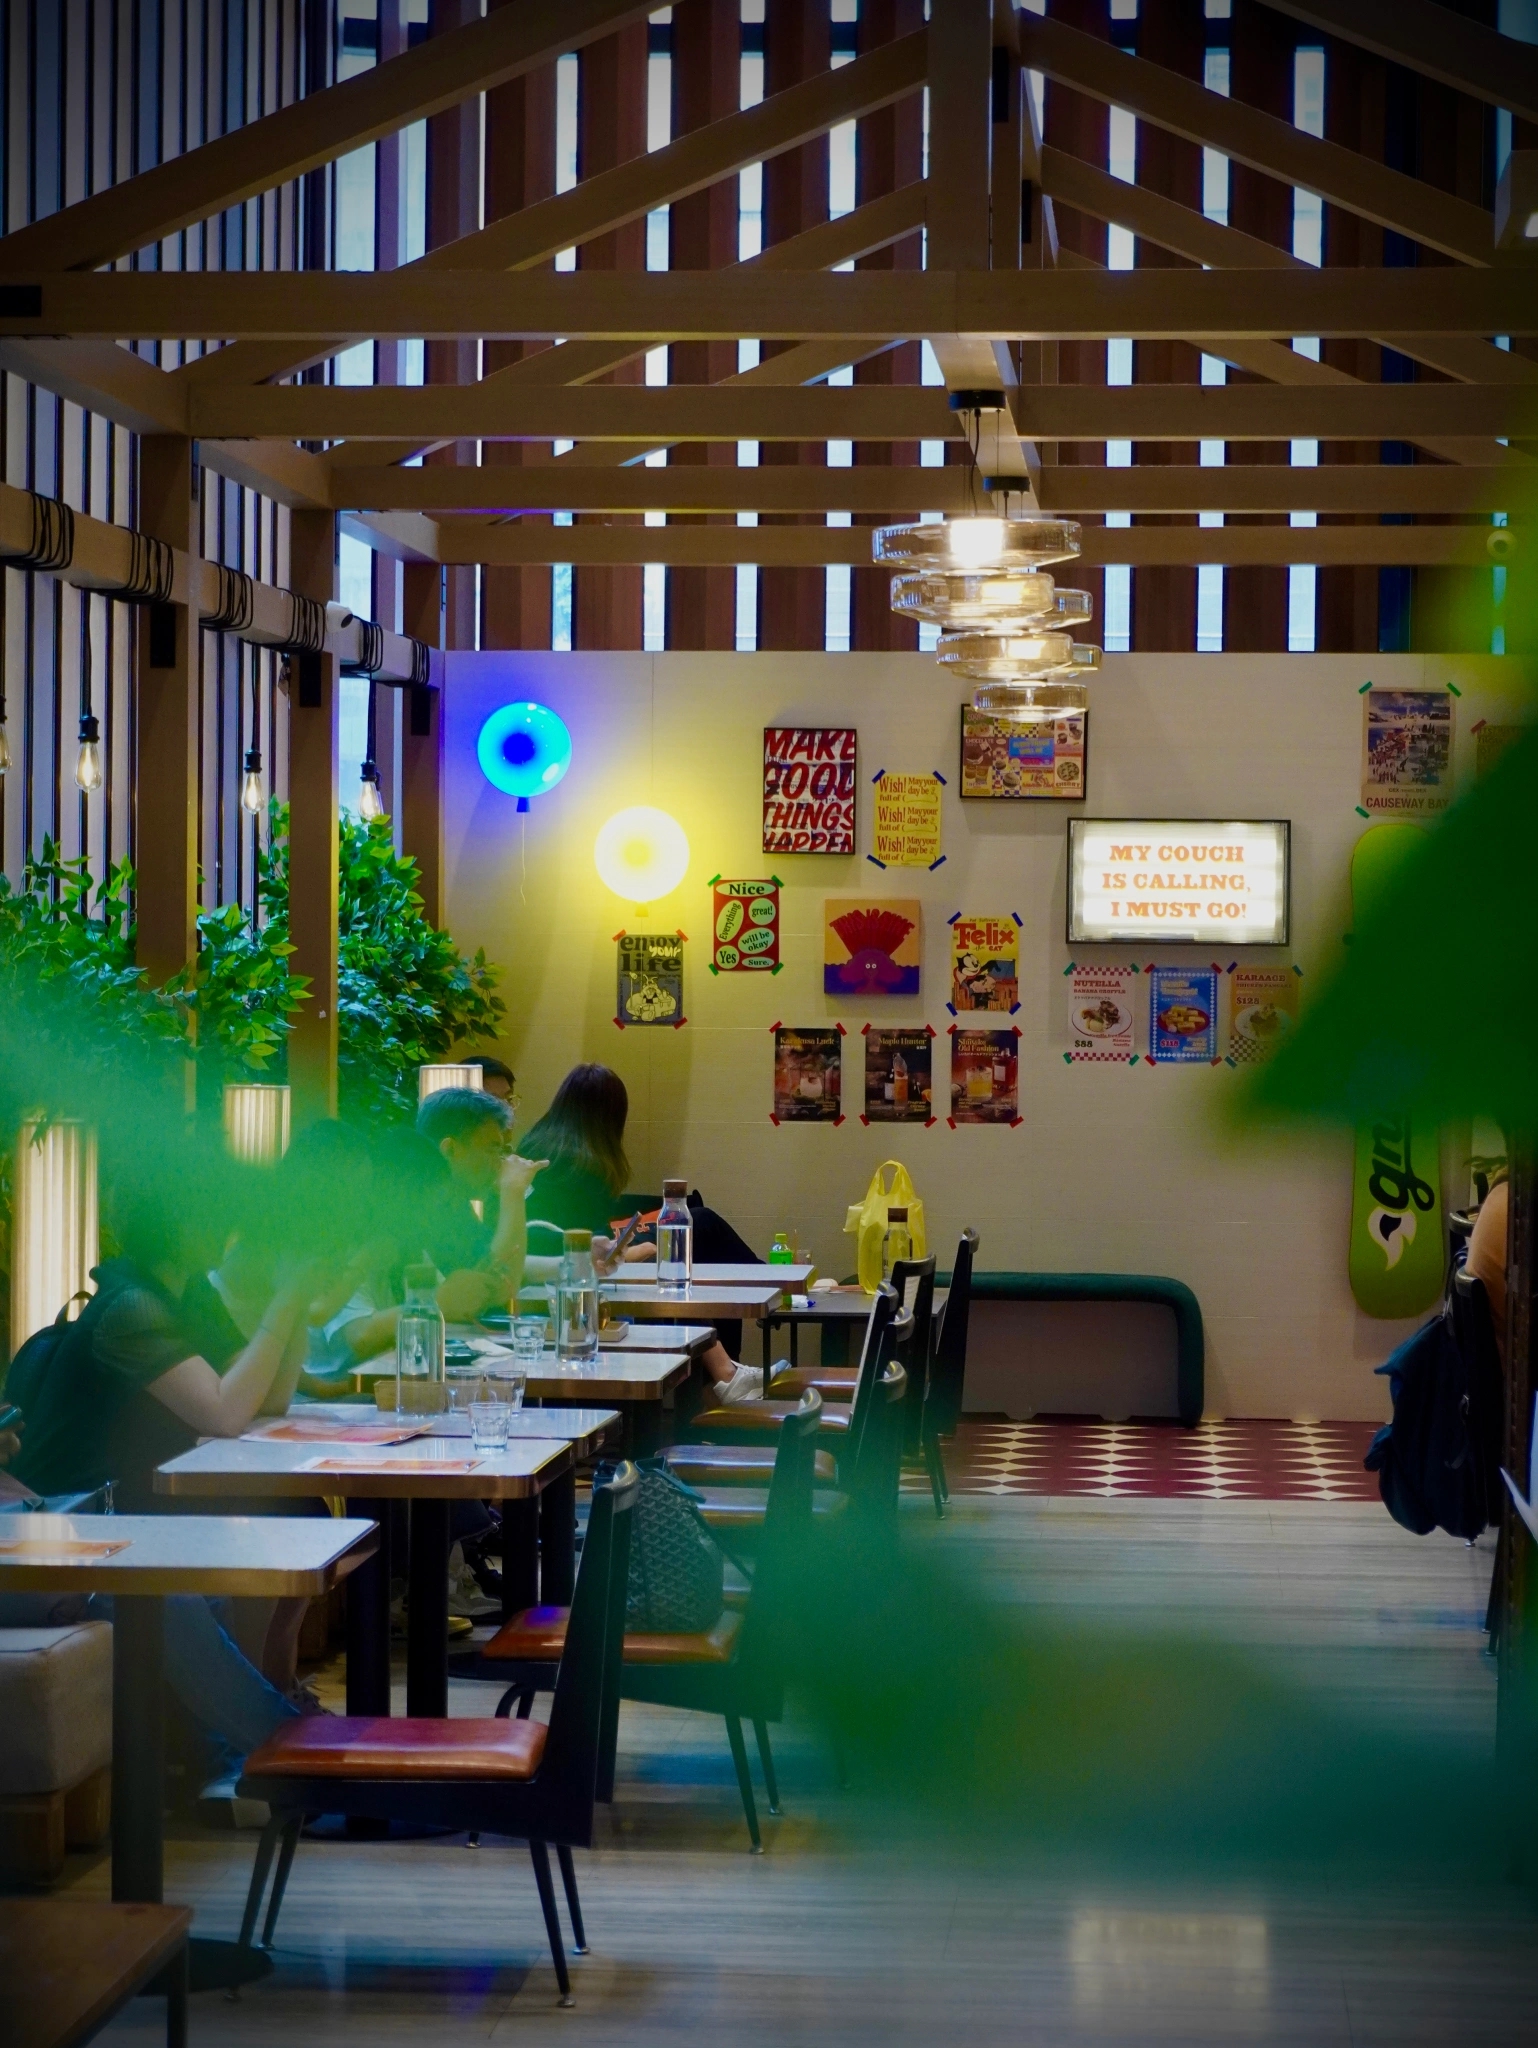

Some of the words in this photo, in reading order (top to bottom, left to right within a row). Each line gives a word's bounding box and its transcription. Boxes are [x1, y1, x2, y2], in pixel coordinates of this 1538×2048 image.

[764, 730, 854, 760] MAKE
[879, 776, 907, 793] Wish!
[908, 777, 922, 787] May
[908, 786, 920, 796] day
[1366, 797, 1424, 809] CAUSEWAY
[1427, 798, 1449, 809] BAY
[764, 801, 853, 830] THINGS
[878, 806, 906, 823] Wish!
[907, 807, 921, 816] May
[907, 816, 920, 826] day
[877, 836, 906, 853] Wish!
[906, 836, 920, 846] May
[906, 846, 919, 856] day
[1109, 844, 1151, 862] MY
[1157, 845, 1244, 862] COUCH
[729, 882, 765, 895] Nice
[1102, 873, 1127, 889] IS
[1132, 873, 1251, 893] CALLING,
[751, 905, 773, 918] great!
[1110, 901, 1120, 917] I
[1126, 902, 1201, 918] MUST
[1206, 902, 1247, 919] GO!
[719, 903, 742, 941] Everything
[741, 933, 759, 945] will
[759, 930, 770, 940] be
[953, 922, 1015, 950] Felix
[748, 940, 769, 952] okay
[621, 952, 681, 971] life
[719, 950, 737, 964] Yes
[1073, 980, 1121, 988] NUTELLA
[1236, 997, 1259, 1005] $128
[1074, 1040, 1093, 1048] $88
[1368, 1114, 1435, 1212] gn
